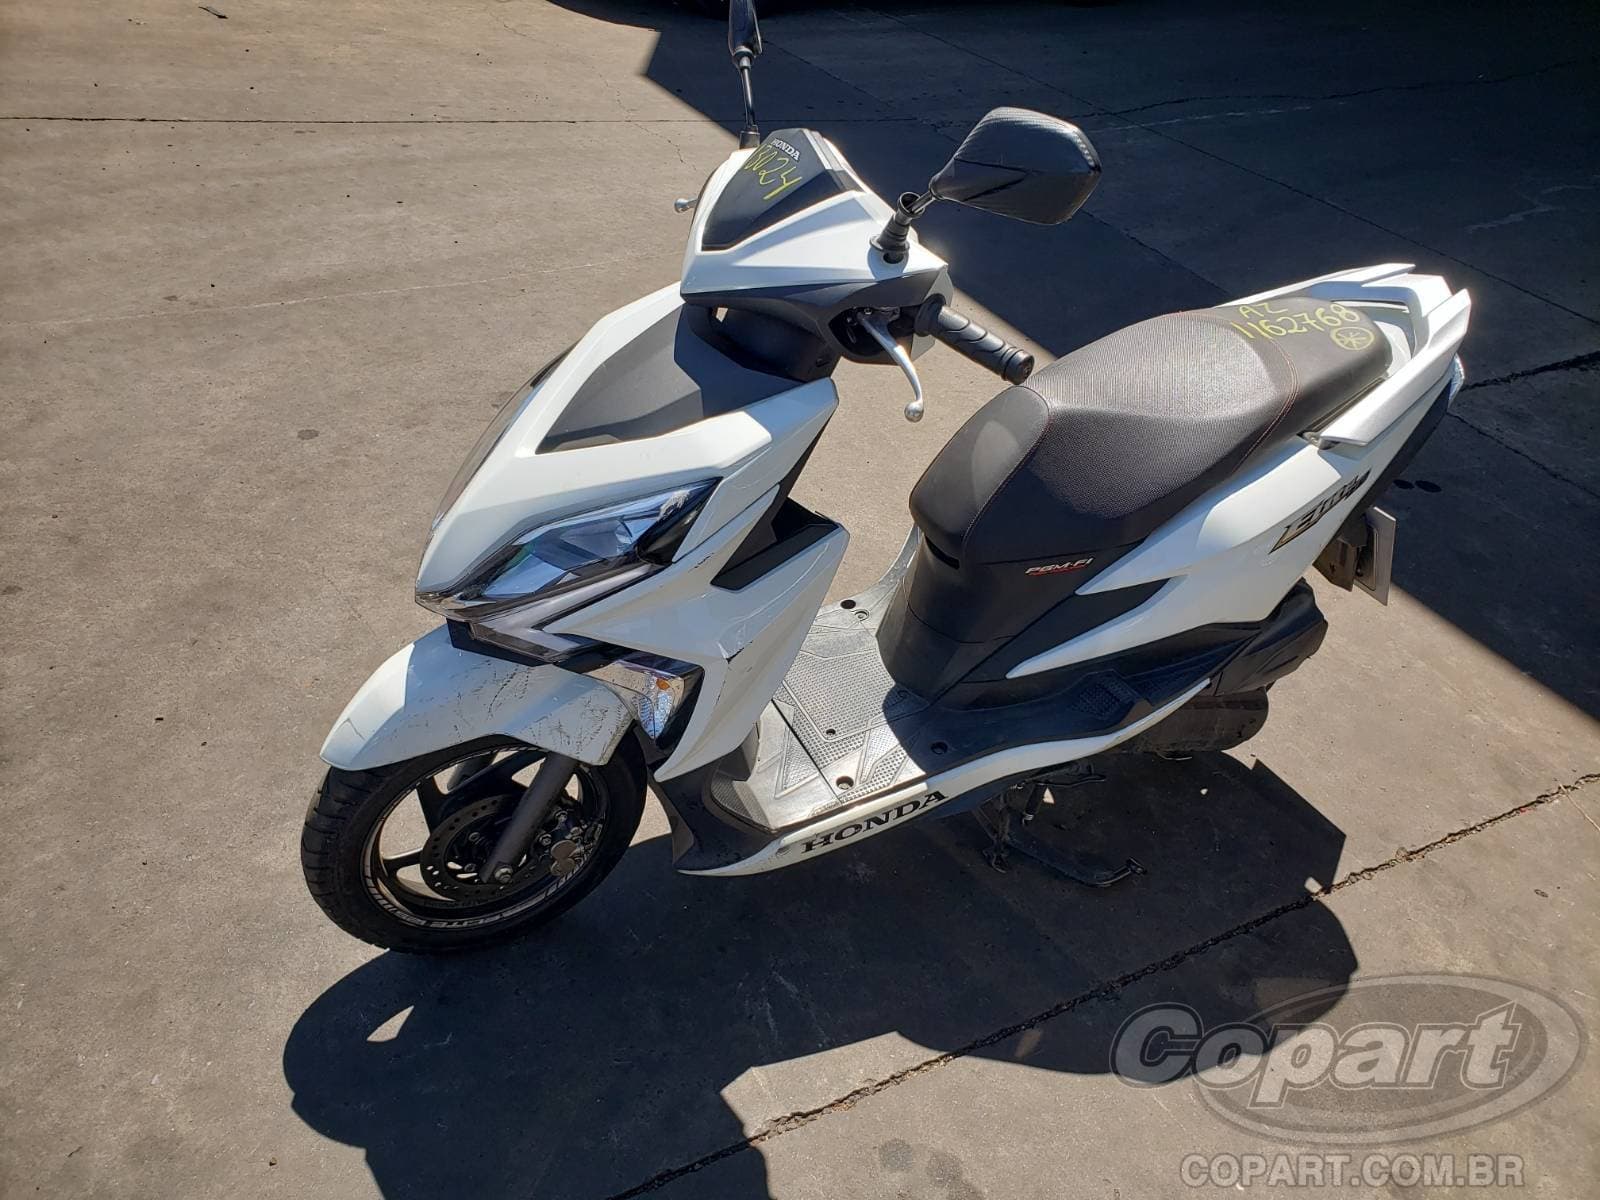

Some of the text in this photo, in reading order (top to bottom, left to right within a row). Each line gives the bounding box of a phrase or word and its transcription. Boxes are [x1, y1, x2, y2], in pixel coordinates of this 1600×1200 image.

[771, 139, 801, 161] HONDA
[1231, 303, 1360, 339] 1162768
[802, 790, 949, 853] HONDA
